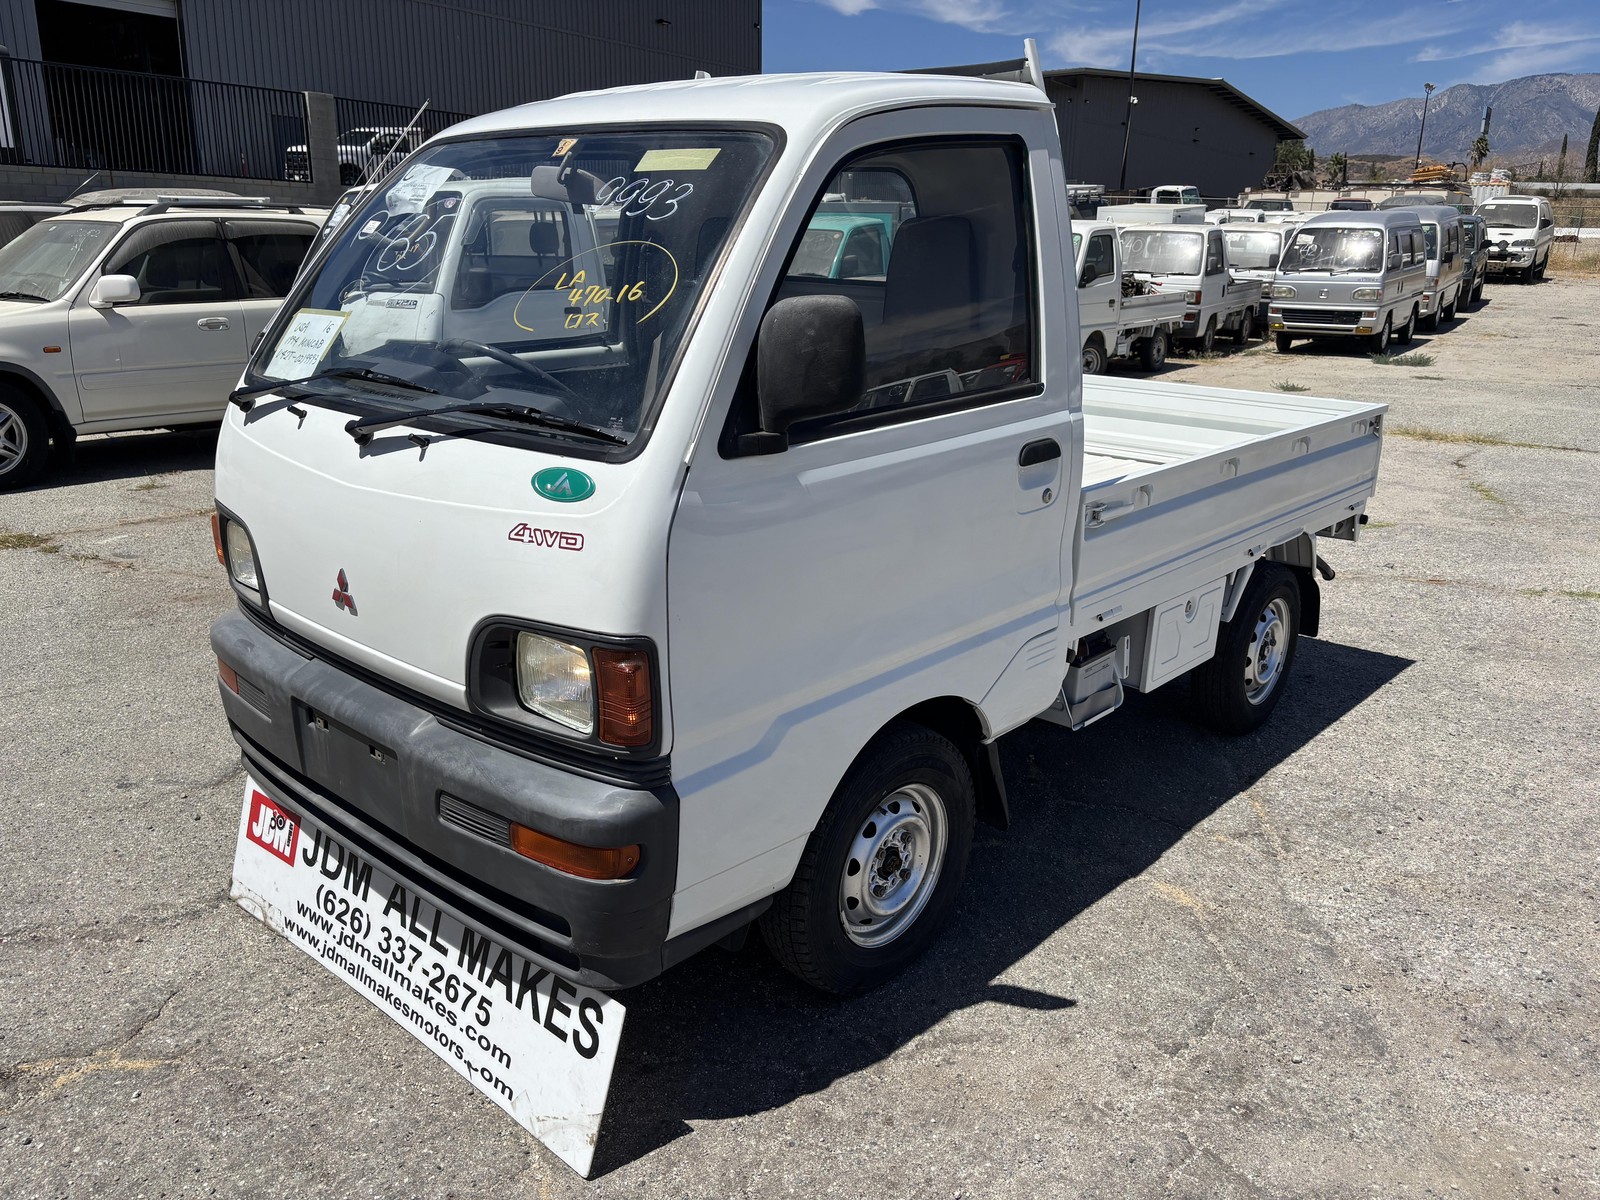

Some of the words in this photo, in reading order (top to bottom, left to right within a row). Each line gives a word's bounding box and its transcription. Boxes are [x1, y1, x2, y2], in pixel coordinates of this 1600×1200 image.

[592, 176, 694, 221] 9993
[554, 270, 586, 291] LA
[568, 281, 645, 307] 470-16
[323, 320, 335, 334] 16
[508, 522, 585, 552] 4WD
[252, 803, 295, 858] JDM
[302, 828, 373, 902] JDM
[383, 883, 448, 957] ALL
[458, 931, 604, 1060] MAKES
[316, 884, 372, 940] (626)
[378, 928, 492, 1027] 337-2675
[296, 899, 512, 1070] www.jdmallmakes.com
